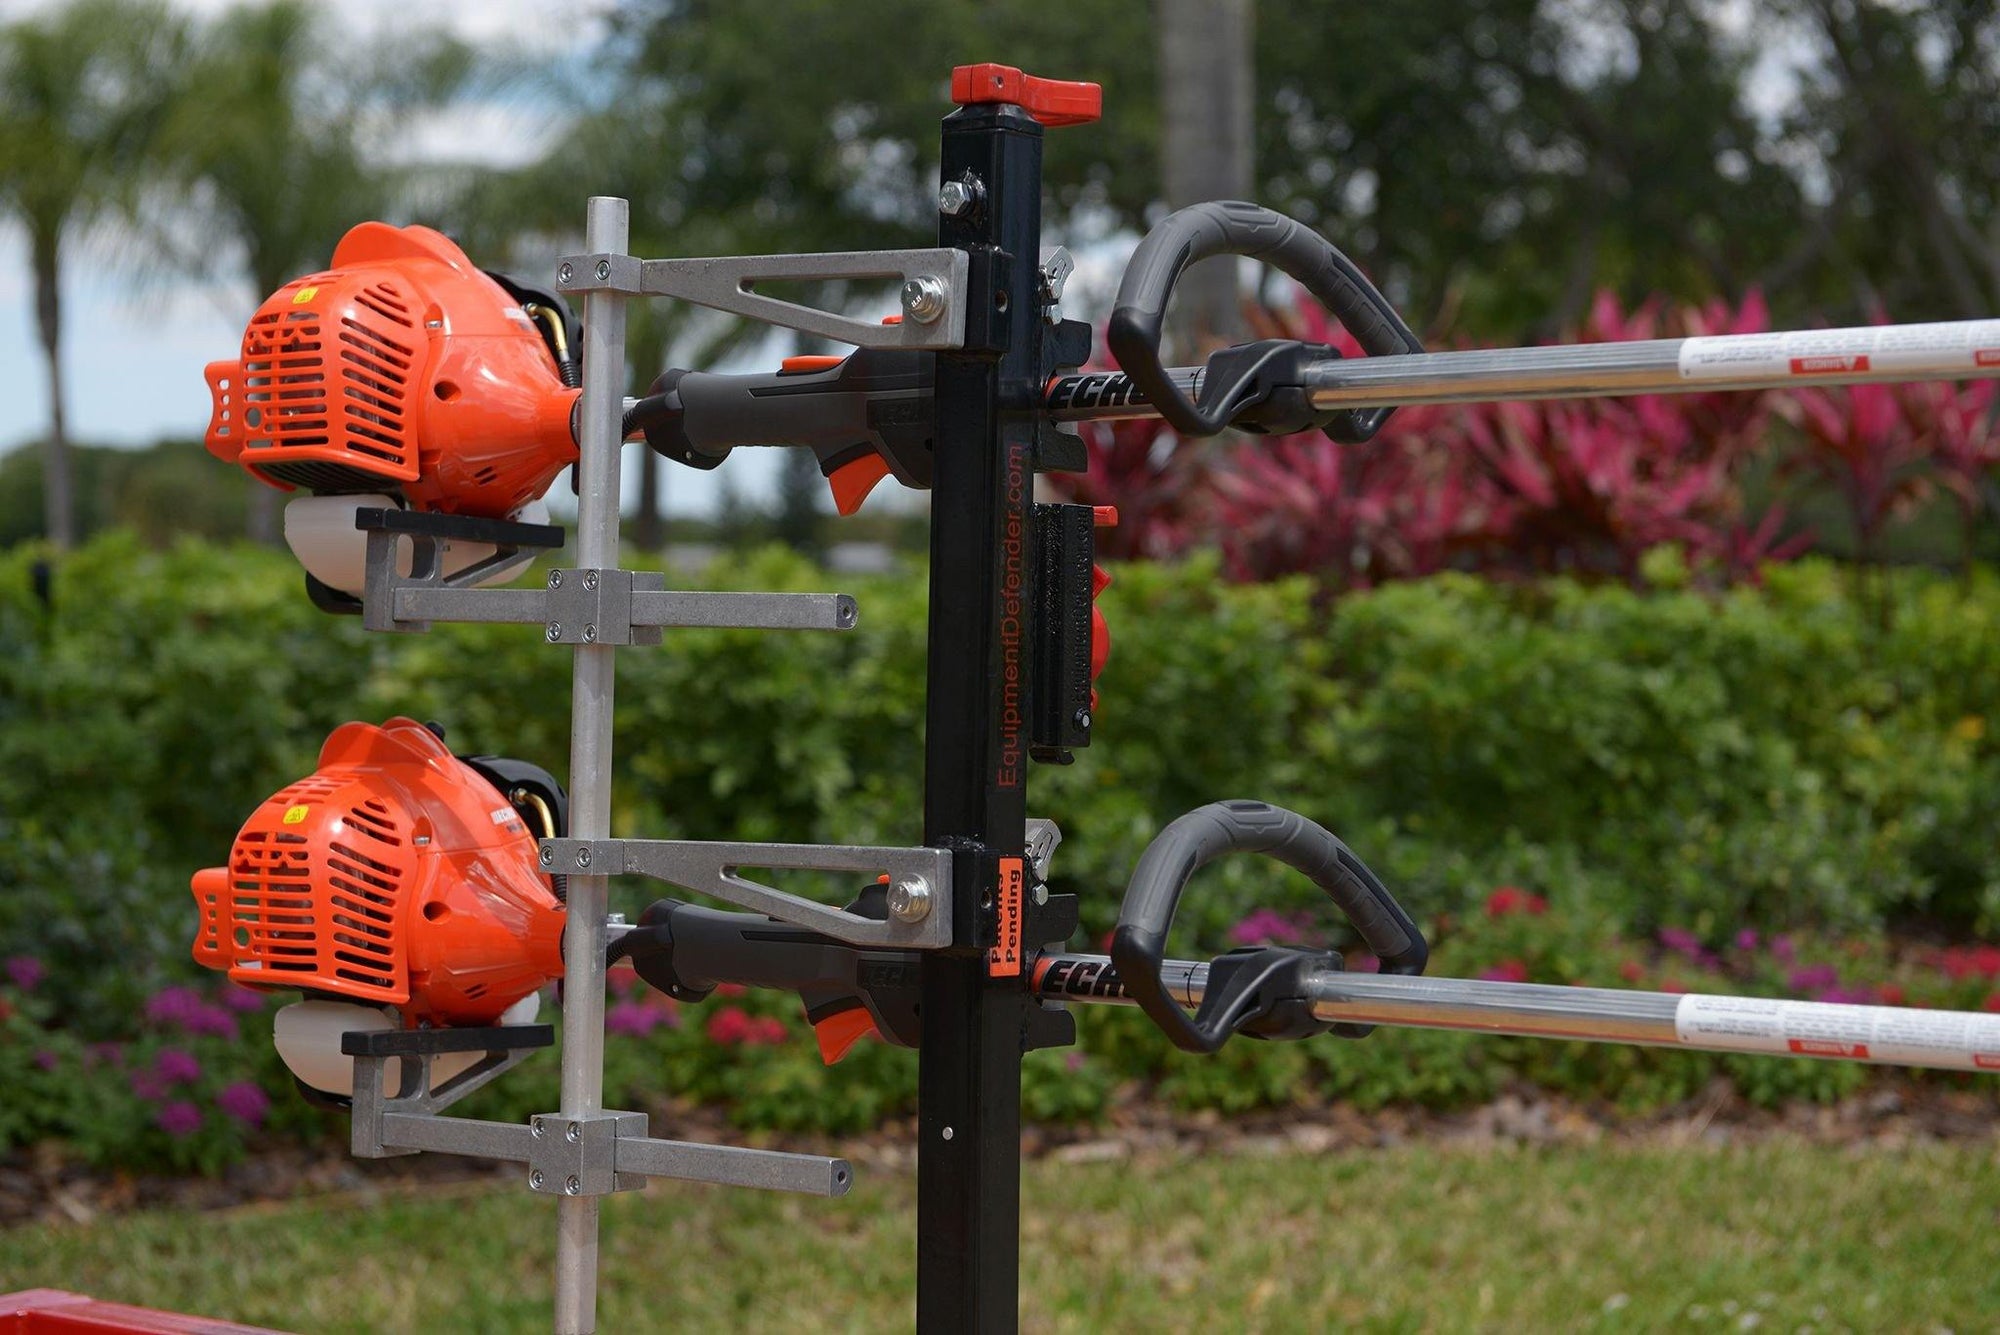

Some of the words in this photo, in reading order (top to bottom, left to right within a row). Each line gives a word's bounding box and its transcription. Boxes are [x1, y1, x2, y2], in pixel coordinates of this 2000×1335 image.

[998, 445, 1023, 787] EquipmentDefender.com
[1005, 869, 1021, 962] Pending
[1043, 960, 1133, 997] ECH
